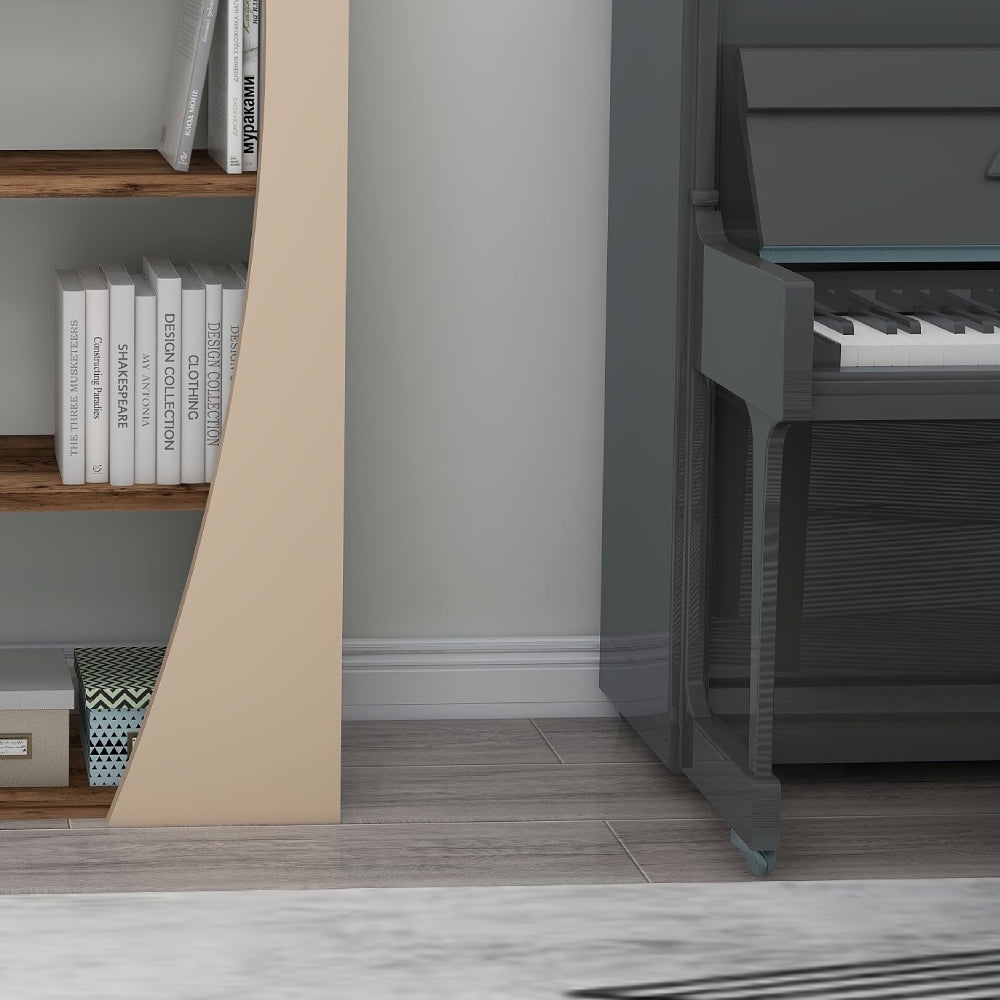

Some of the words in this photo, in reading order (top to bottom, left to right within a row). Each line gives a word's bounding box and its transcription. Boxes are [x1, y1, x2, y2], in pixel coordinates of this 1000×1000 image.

[243, 76, 258, 154] мураками
[70, 319, 79, 392] MUSKETEERS
[91, 336, 102, 385] Constructing
[142, 354, 150, 370] MY
[164, 313, 175, 362] DESIGN
[208, 322, 220, 371] DESIGN
[118, 344, 128, 428] SHAKESPEARE
[142, 374, 150, 427] ANTONIA
[164, 366, 175, 450] COLLECTION
[188, 354, 199, 420] CLOTHING
[207, 372, 220, 447] COLLECTION
[70, 396, 78, 431] THREE
[70, 432, 78, 456] THE
